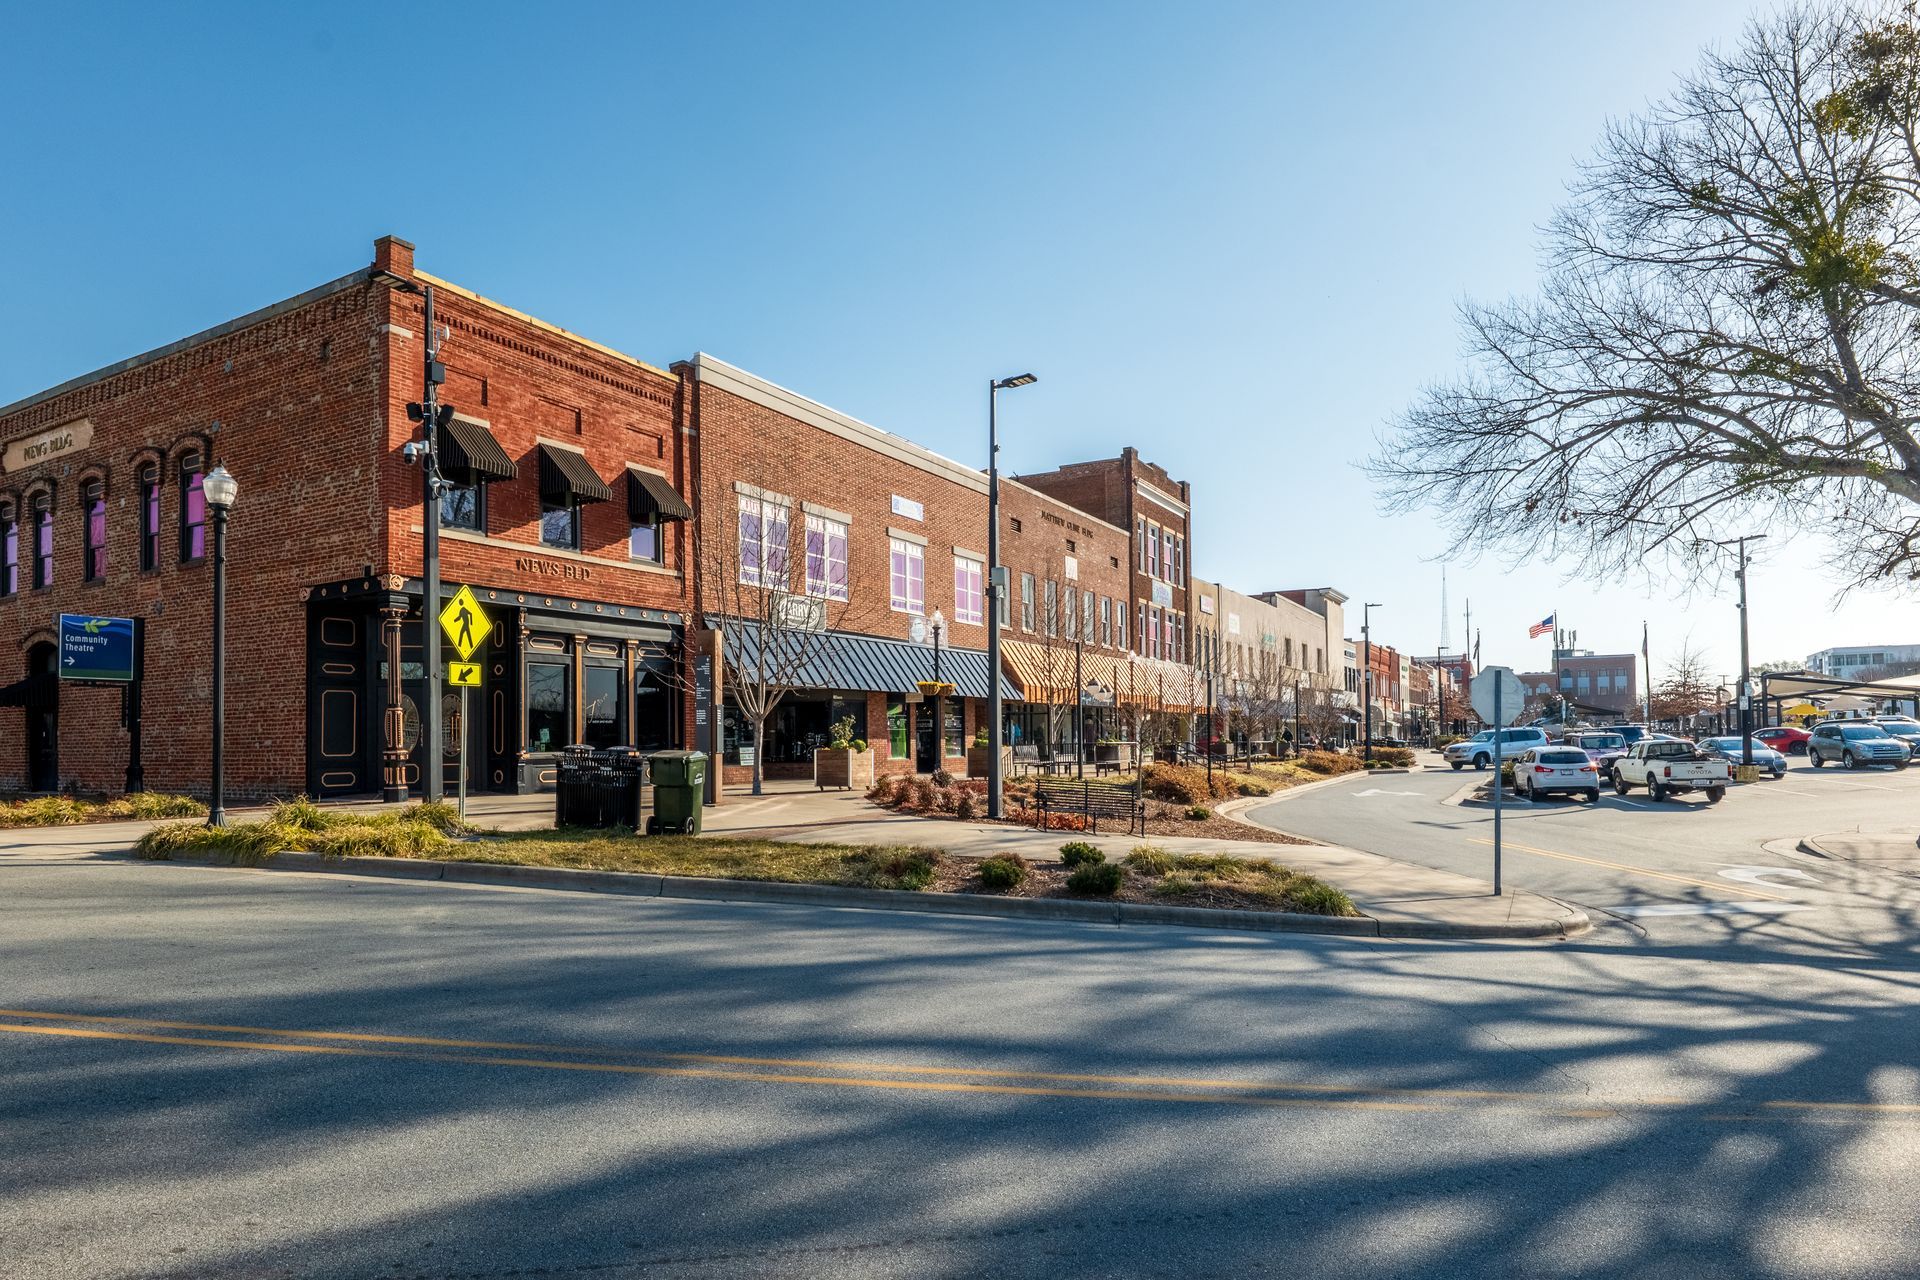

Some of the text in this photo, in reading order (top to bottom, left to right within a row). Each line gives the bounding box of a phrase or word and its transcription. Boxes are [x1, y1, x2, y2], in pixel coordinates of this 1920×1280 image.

[23, 441, 48, 461] NEWS
[515, 557, 591, 581] NEWS BLD
[65, 634, 108, 646] Community
[65, 643, 94, 653] Theatre
